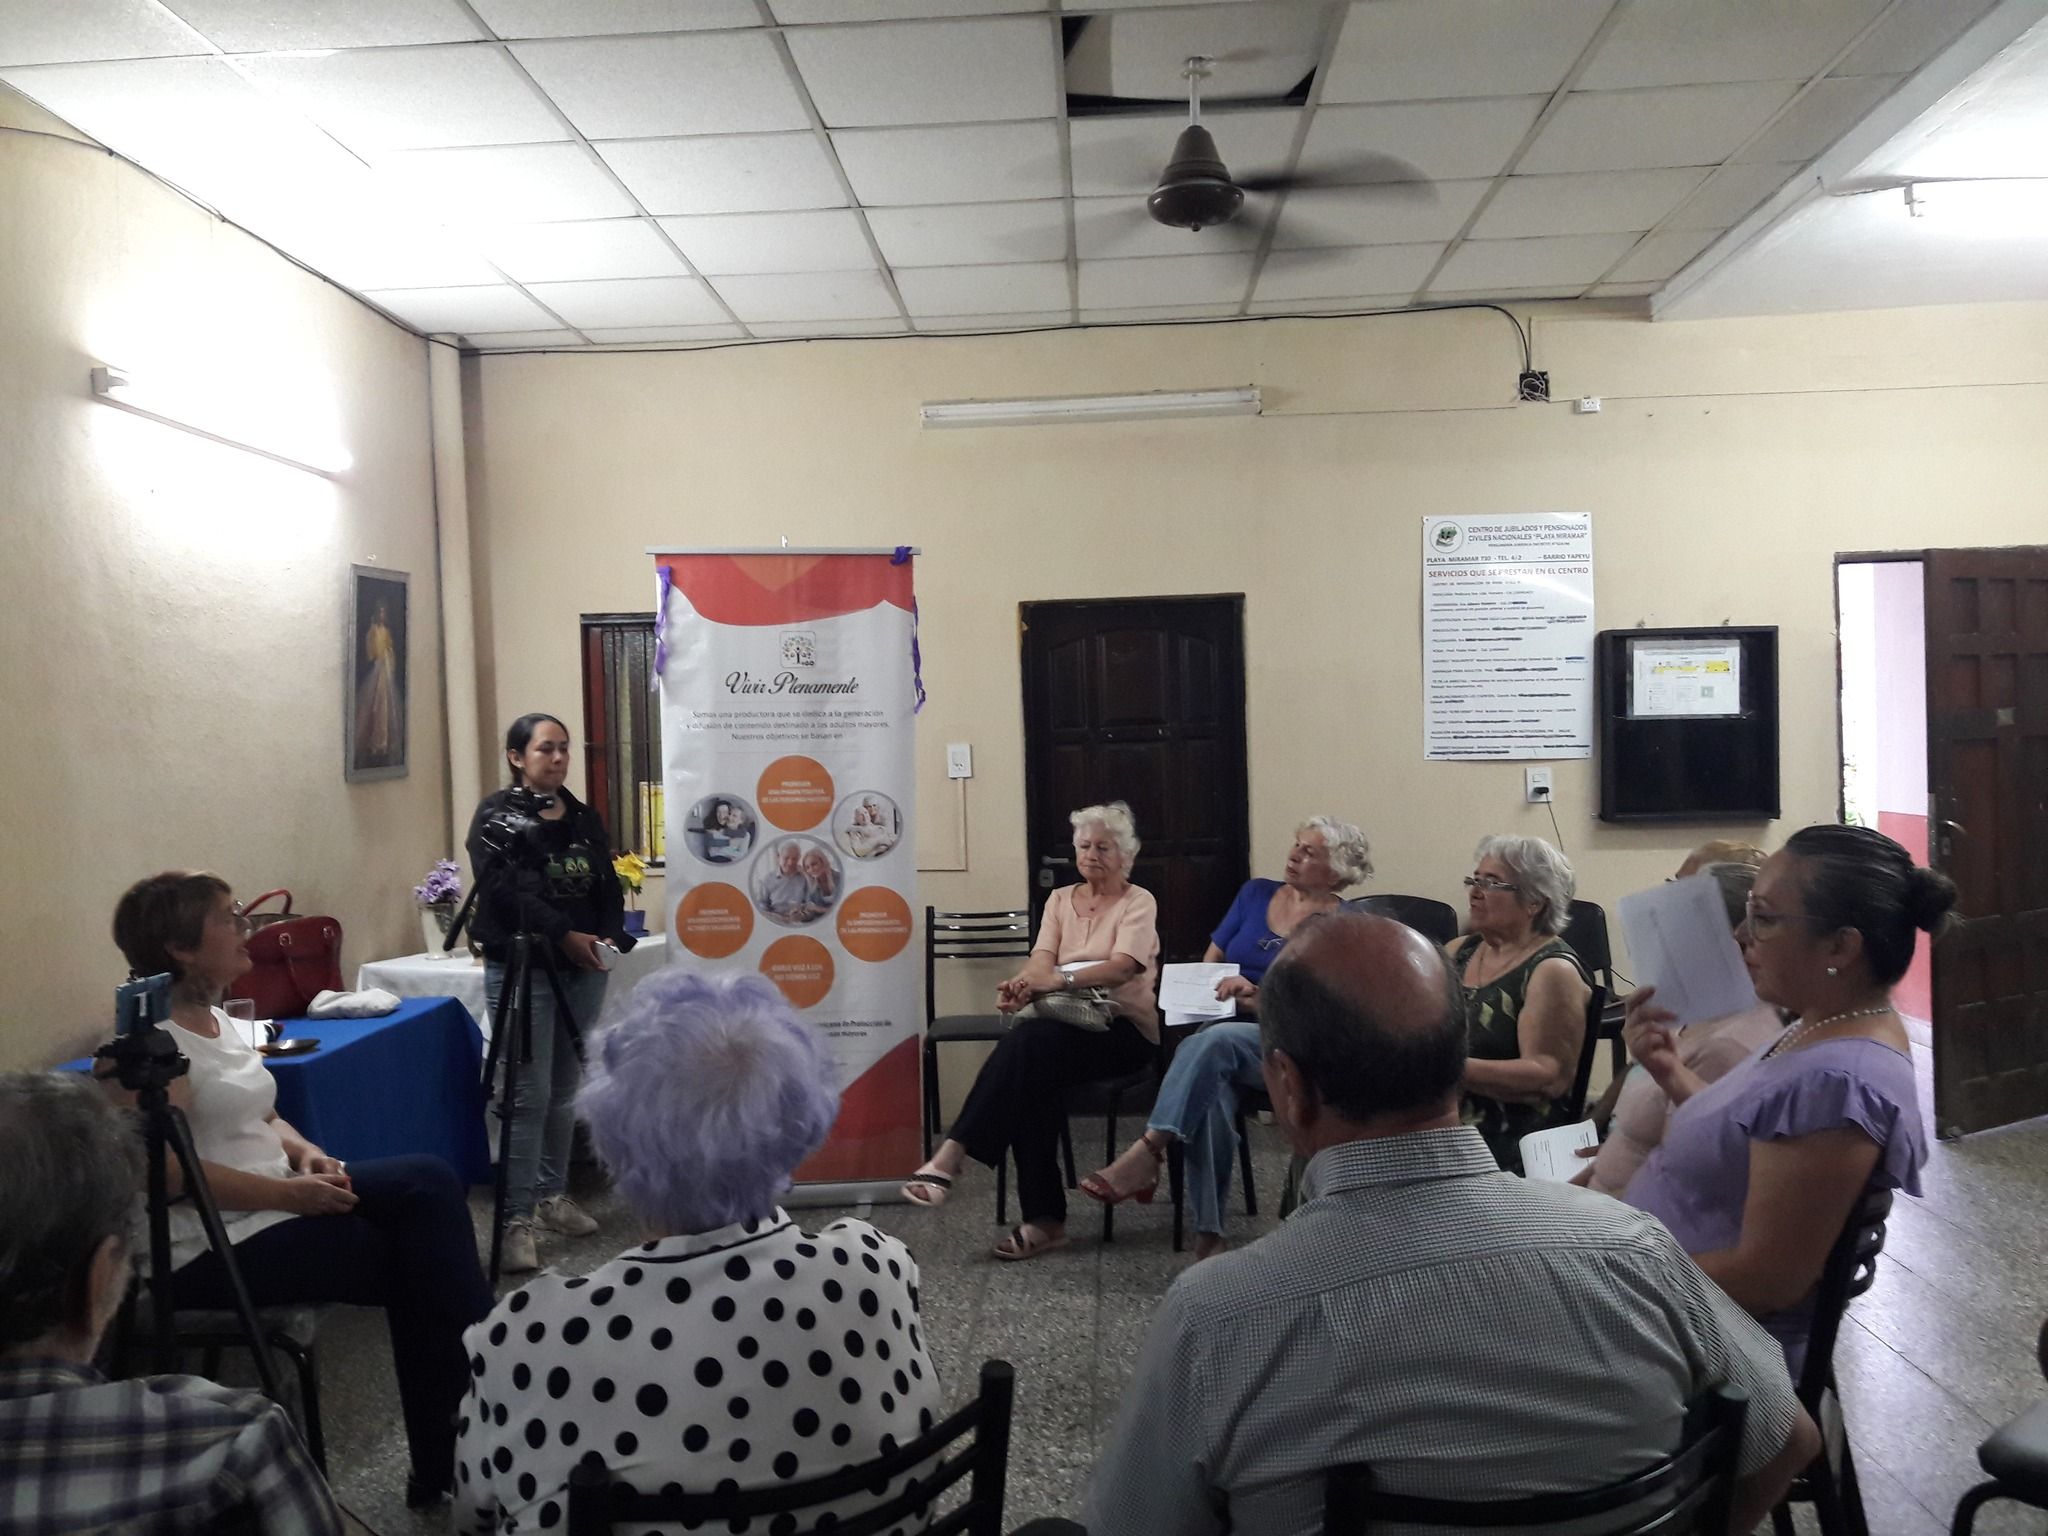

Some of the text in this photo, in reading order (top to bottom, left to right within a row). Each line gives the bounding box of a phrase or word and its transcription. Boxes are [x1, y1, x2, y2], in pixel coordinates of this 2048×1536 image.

[1470, 569, 1486, 577] QUE
[1498, 568, 1533, 576] PRESTAN
[725, 671, 859, 695] Vivir Plenamente
[734, 711, 775, 719] productora
[776, 711, 791, 719] que
[843, 710, 884, 718] generación
[765, 733, 799, 741] objetivos
